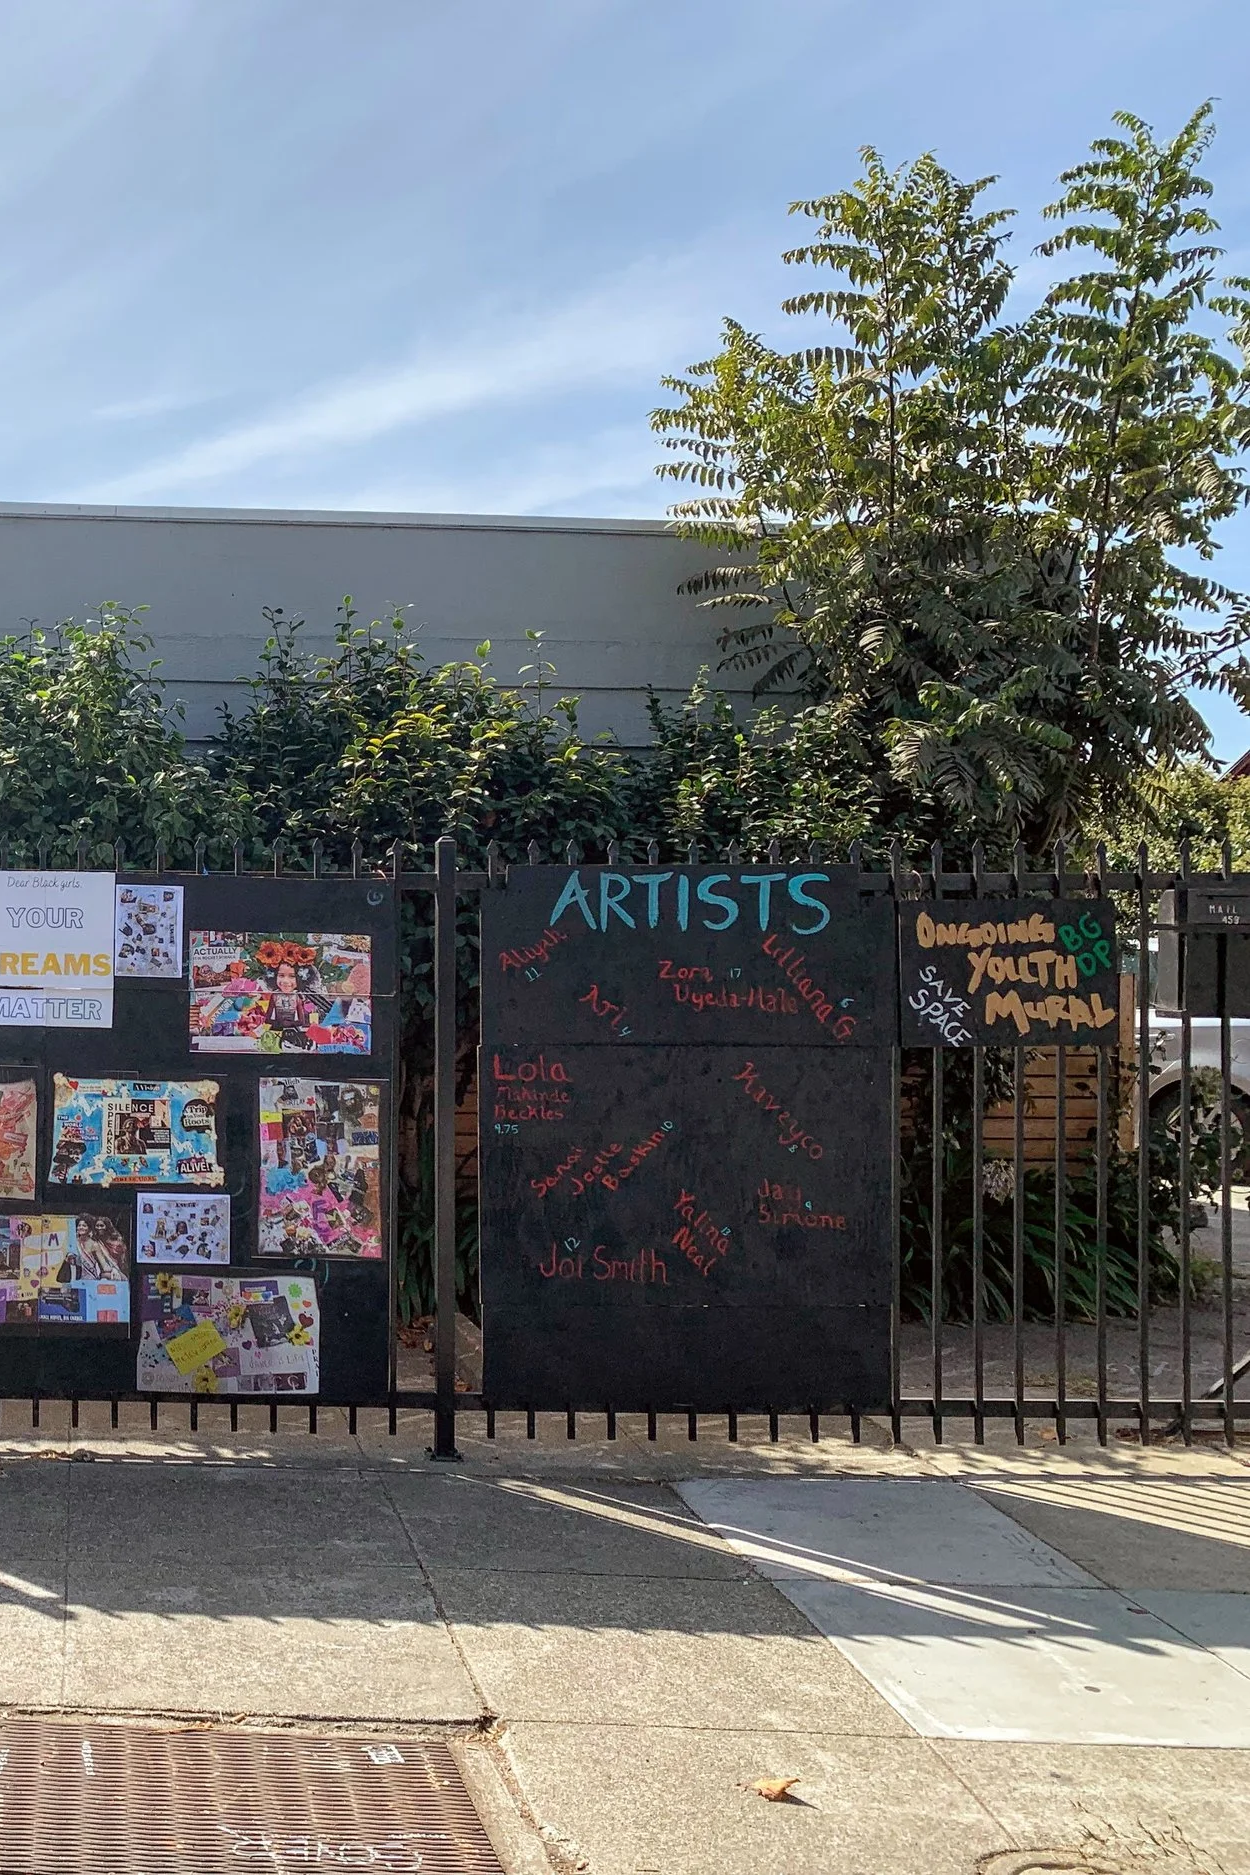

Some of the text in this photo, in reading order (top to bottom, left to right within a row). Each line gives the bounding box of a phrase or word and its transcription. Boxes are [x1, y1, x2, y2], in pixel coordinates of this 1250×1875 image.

[7, 876, 30, 888] Dear
[33, 876, 59, 888] Black
[550, 870, 831, 935] ARTISTS
[1209, 905, 1238, 914] MAIL
[6, 907, 84, 929] YOUR
[193, 947, 237, 956] ACTUALLY
[658, 960, 742, 983] Zora 17
[967, 947, 1078, 995] YOUTH
[918, 965, 972, 1019] SAVE
[909, 988, 973, 1048] SPACE
[493, 1054, 574, 1083] Lola
[108, 1103, 154, 1113] SILENCE
[661, 1120, 674, 1132] 10
[758, 1204, 847, 1231] Simone
[564, 1237, 581, 1252] 12
[540, 1242, 671, 1286] Joi Smith
